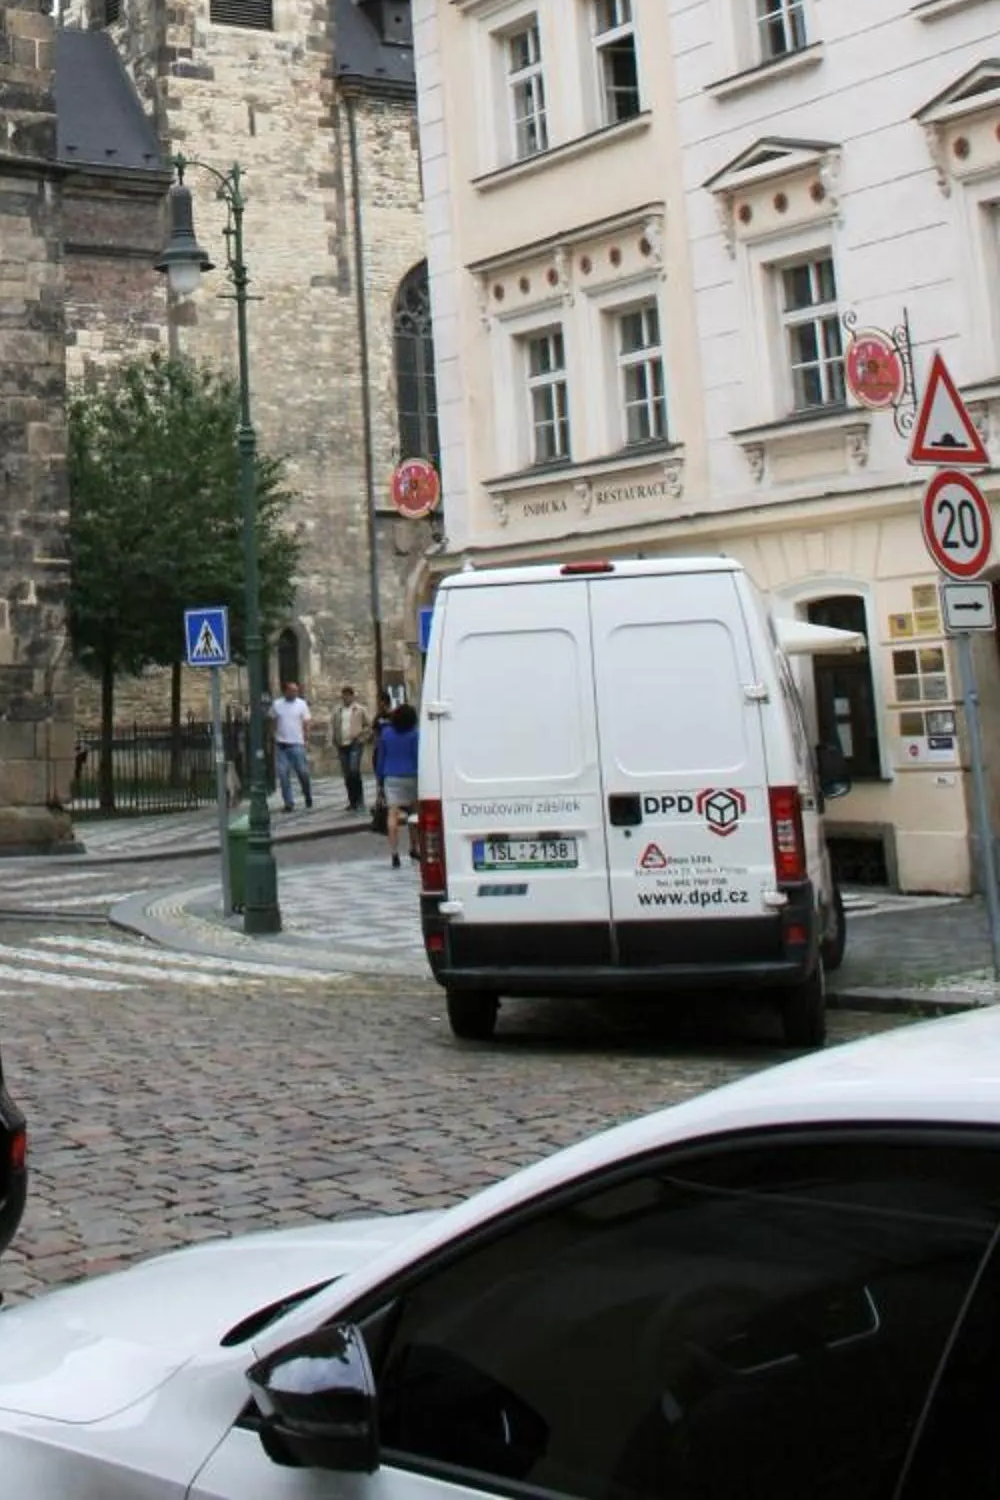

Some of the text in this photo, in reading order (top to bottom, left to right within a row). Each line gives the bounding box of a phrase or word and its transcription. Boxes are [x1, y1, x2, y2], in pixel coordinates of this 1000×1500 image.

[938, 499, 979, 548] 20
[644, 796, 693, 814] DPD
[489, 841, 516, 861] 1SL
[638, 888, 750, 908] www.dpd.cz
